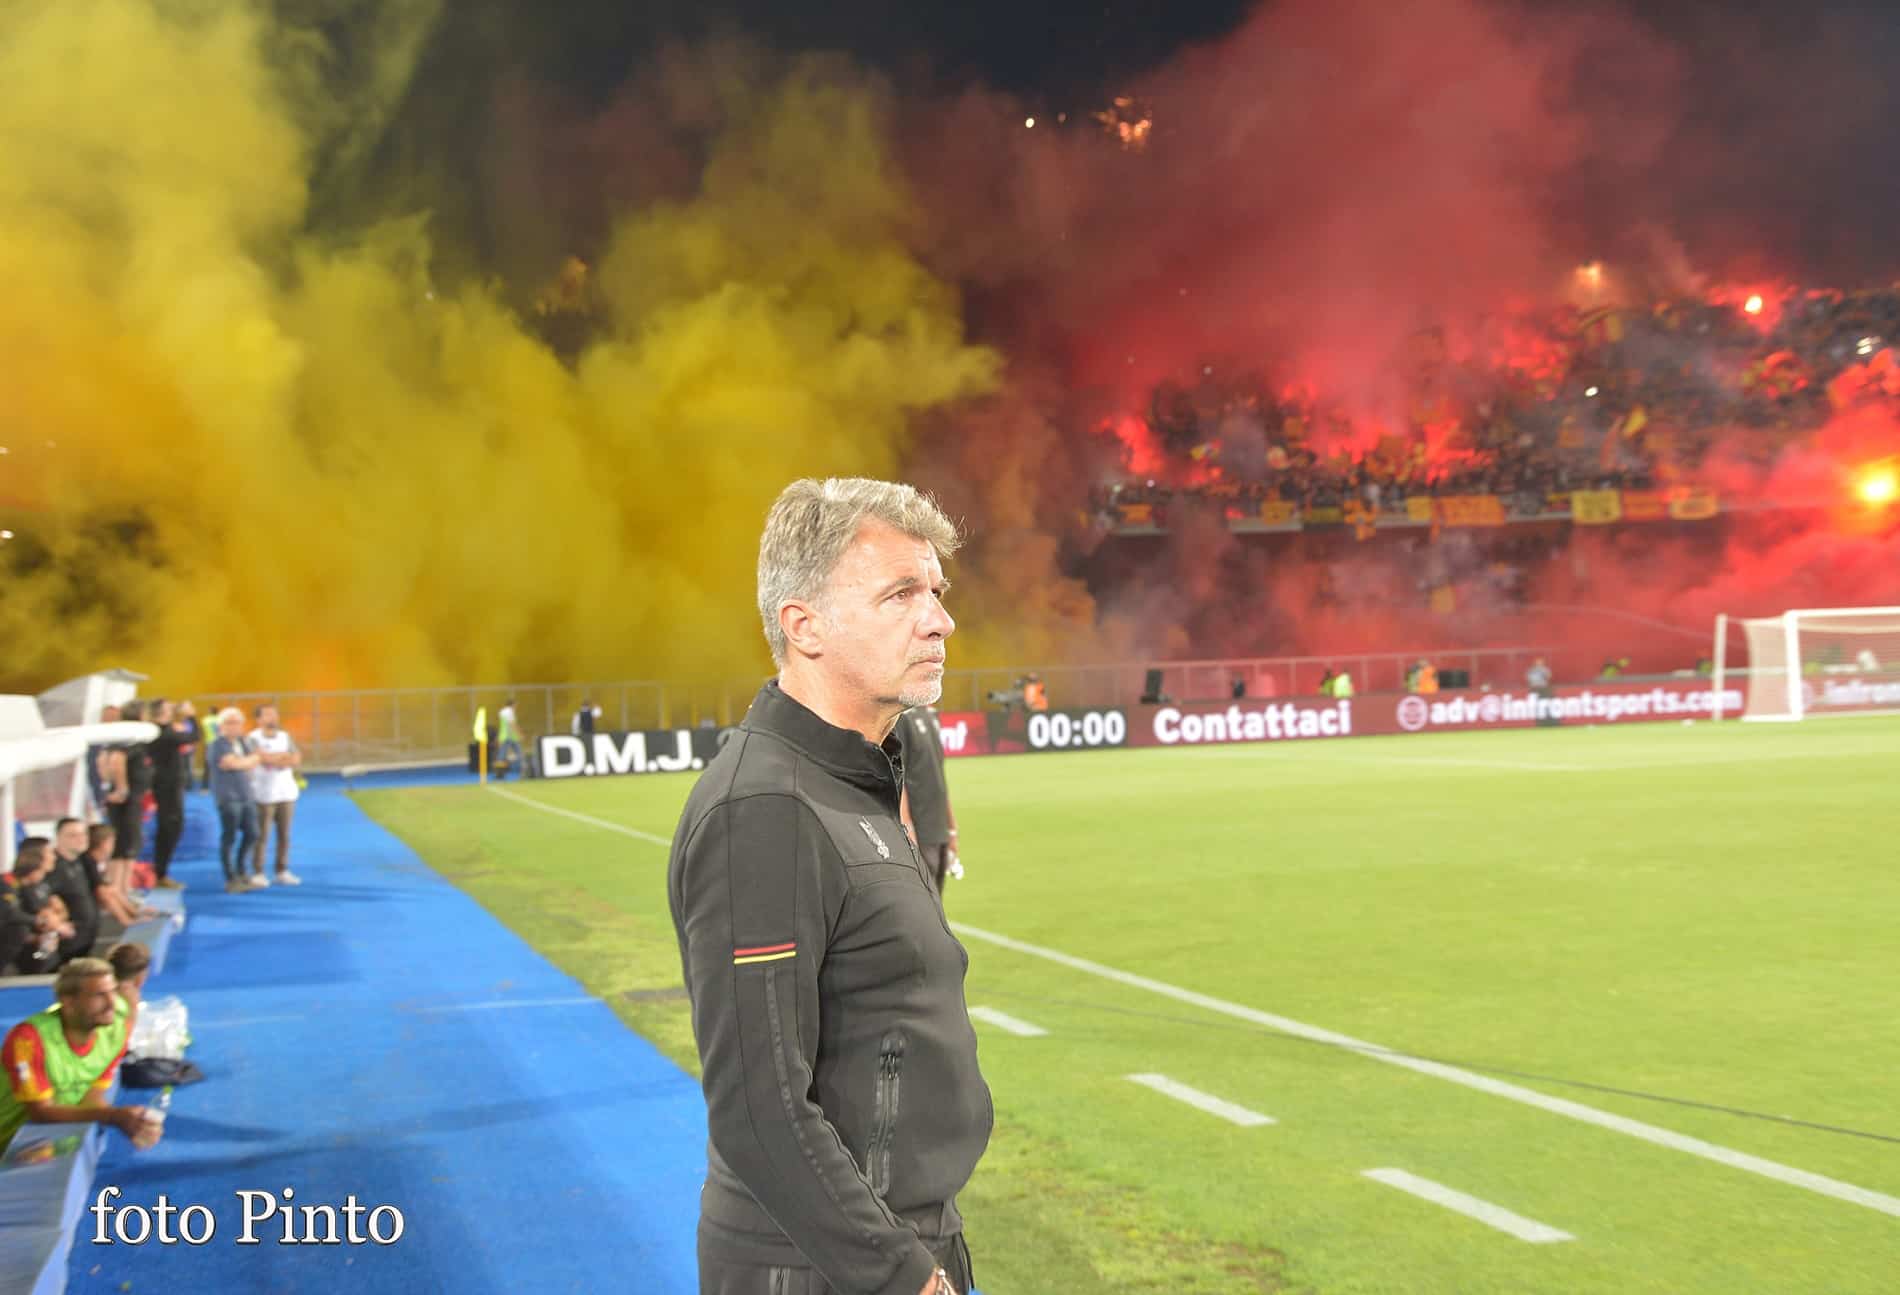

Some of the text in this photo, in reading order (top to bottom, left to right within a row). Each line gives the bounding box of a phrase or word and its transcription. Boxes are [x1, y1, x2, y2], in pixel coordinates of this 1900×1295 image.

[1028, 710, 1125, 747] 00:00
[1154, 700, 1350, 743] Contattaci
[541, 729, 704, 777] D.M.J.
